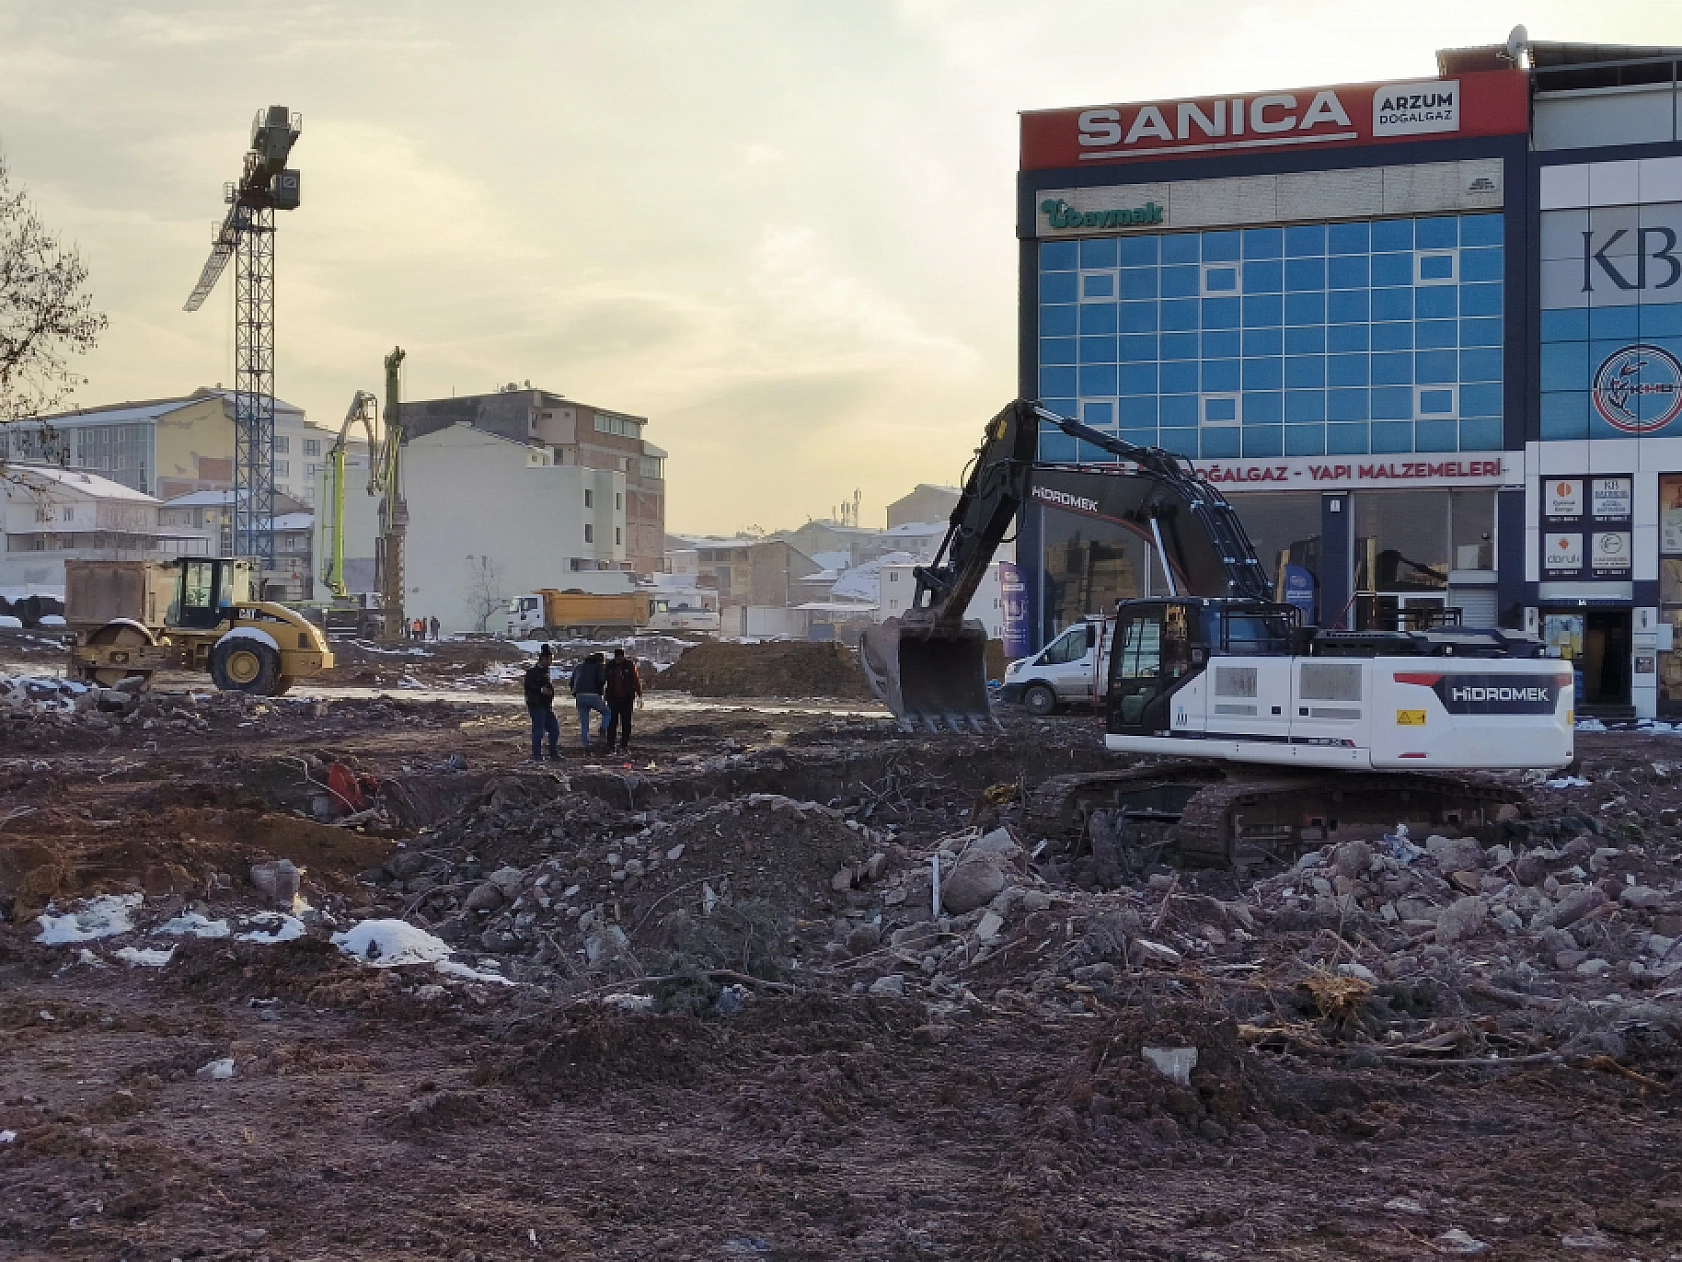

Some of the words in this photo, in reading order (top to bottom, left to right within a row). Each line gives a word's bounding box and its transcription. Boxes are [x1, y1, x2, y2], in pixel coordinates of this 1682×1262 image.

[1380, 91, 1453, 111] ARZUM
[1078, 90, 1352, 146] SANICA
[1066, 202, 1164, 228] baymak
[1308, 465, 1352, 481] YAPI
[1358, 458, 1501, 479] MALZEMELERİ
